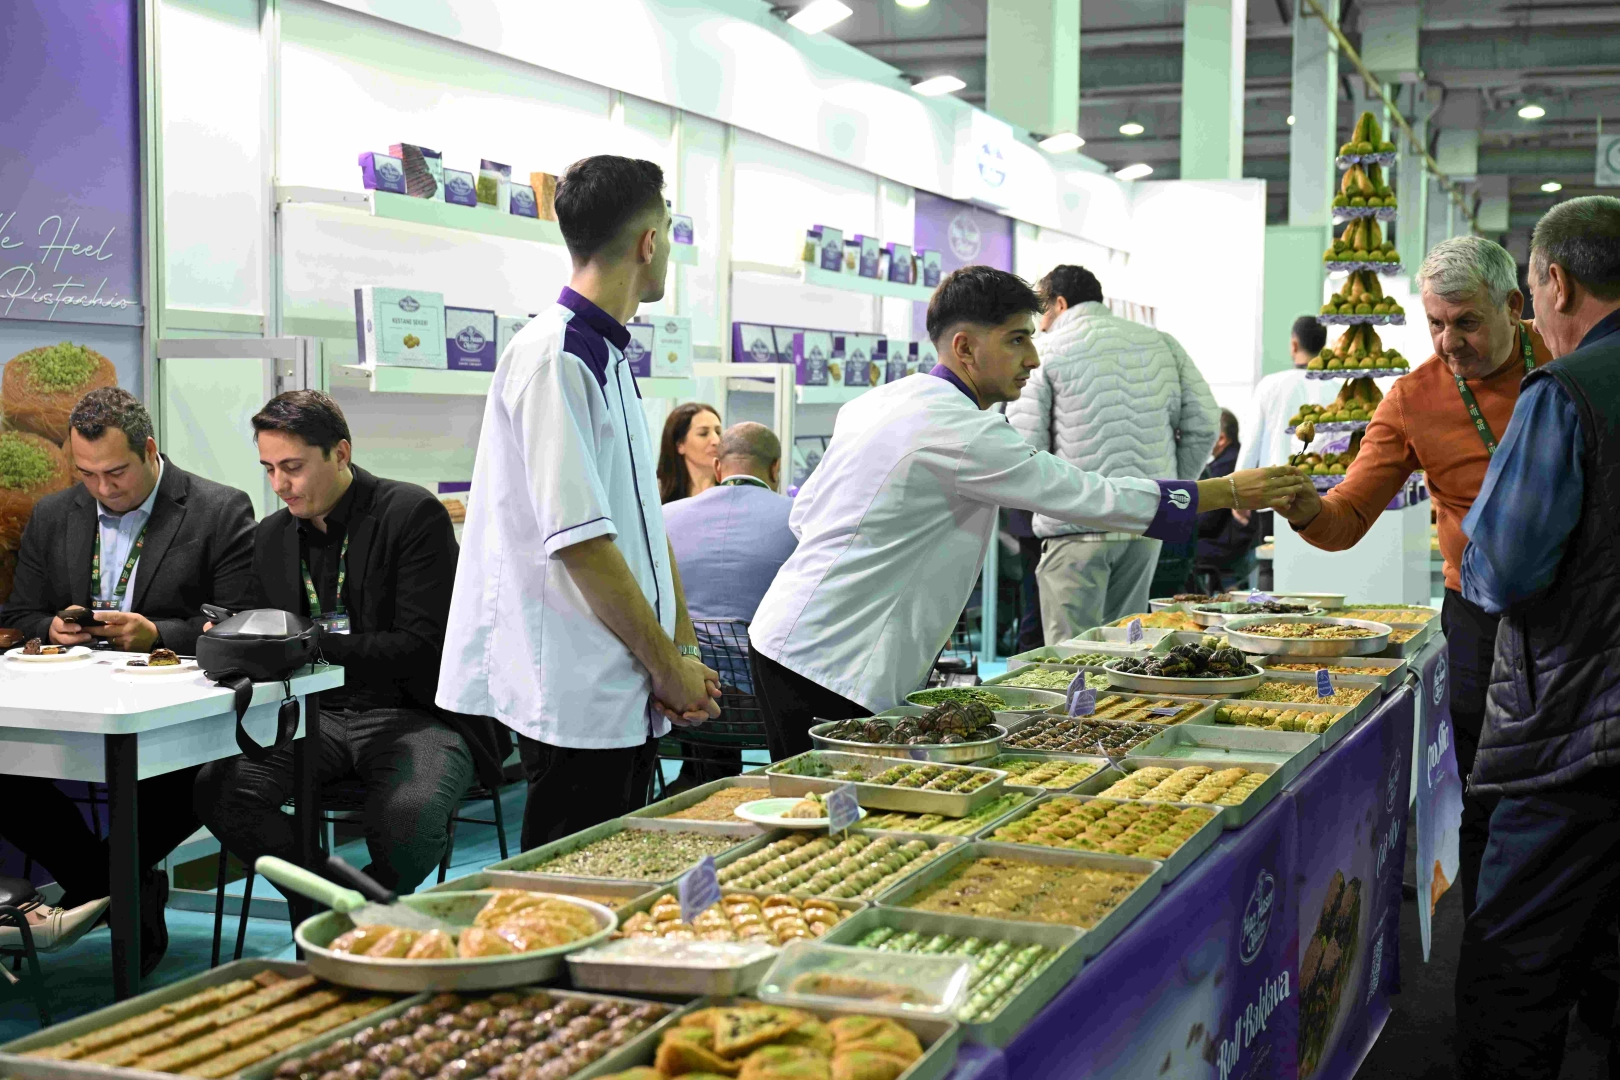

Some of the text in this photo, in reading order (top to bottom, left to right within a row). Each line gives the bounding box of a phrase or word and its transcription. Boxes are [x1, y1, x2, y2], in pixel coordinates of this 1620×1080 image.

[39, 215, 116, 272] Heel
[0, 263, 138, 320] Pistachio
[1217, 1015, 1242, 1080] Roll
[1243, 970, 1291, 1049] Baklava
